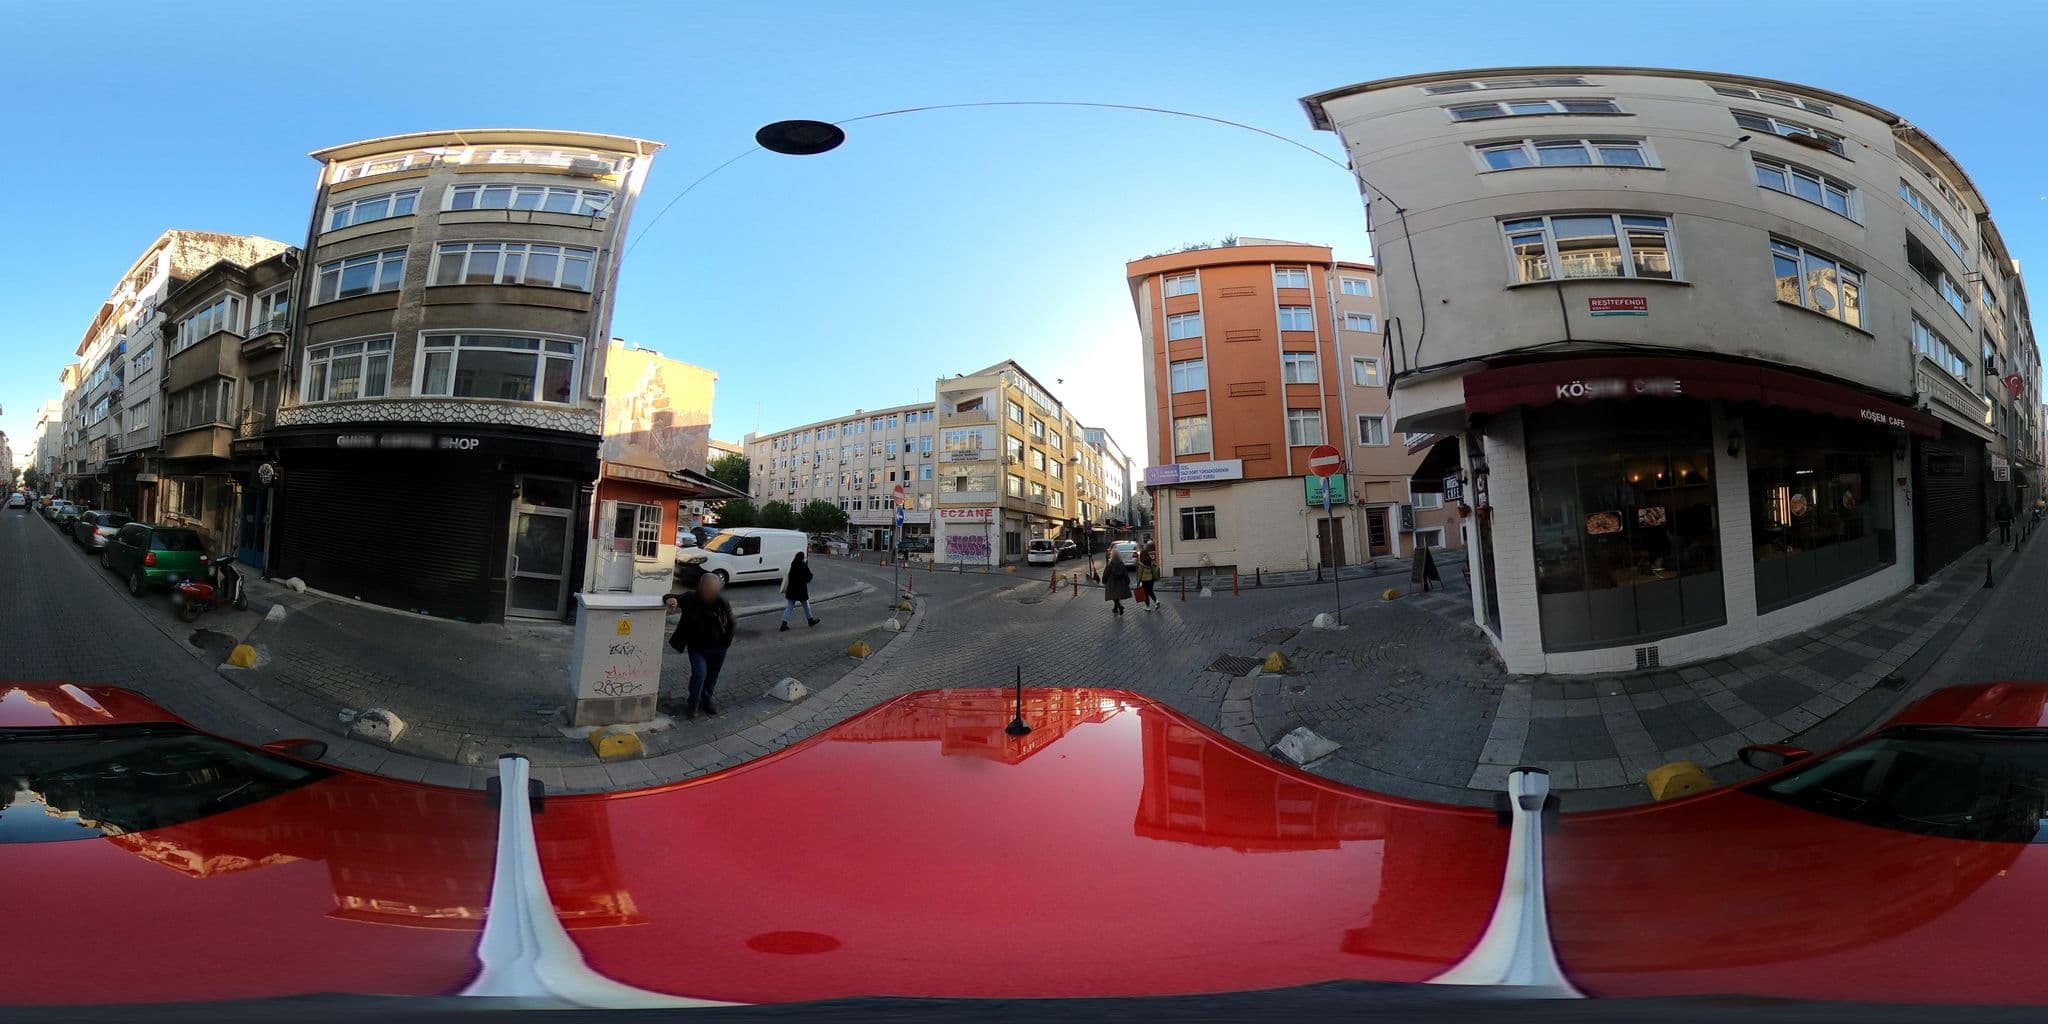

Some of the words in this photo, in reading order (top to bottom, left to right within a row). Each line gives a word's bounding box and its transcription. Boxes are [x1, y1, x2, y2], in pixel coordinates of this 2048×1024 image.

[1860, 408, 1887, 423] KÖŞEM
[1888, 416, 1905, 428] CAFE
[441, 437, 480, 450] HOP
[941, 509, 992, 518] ECZANE
